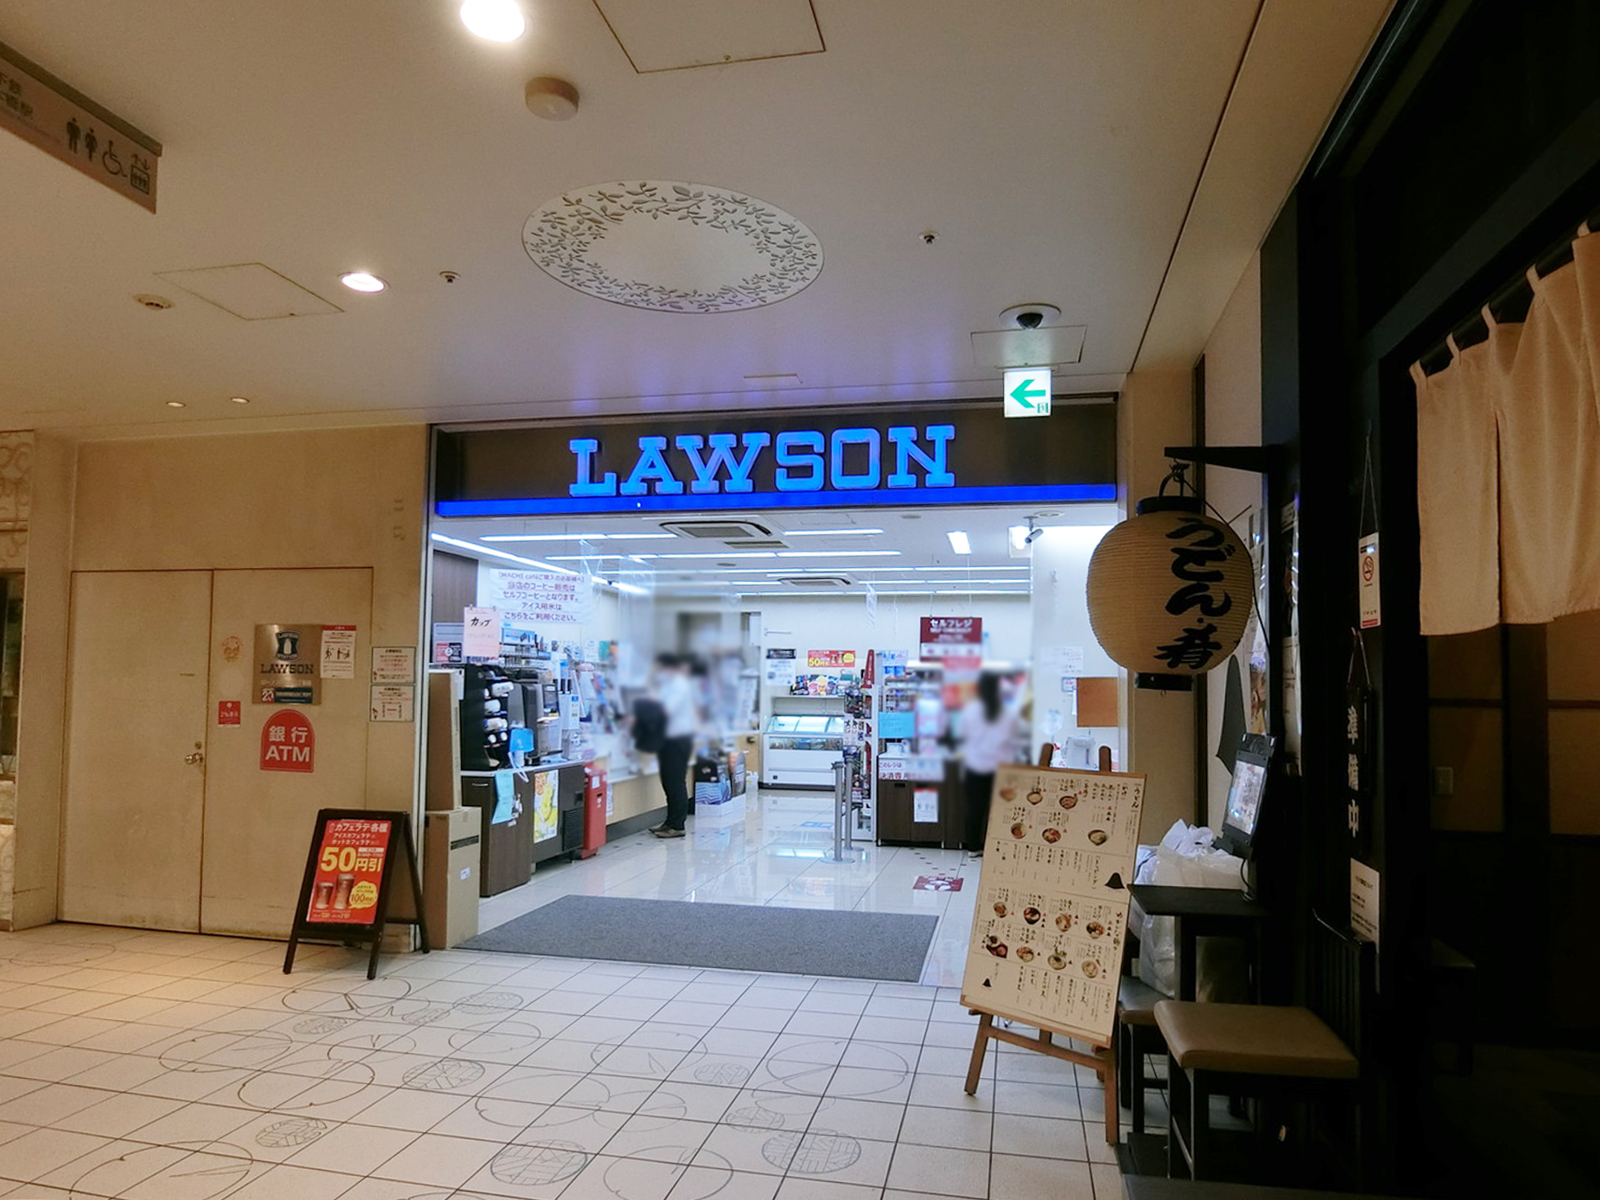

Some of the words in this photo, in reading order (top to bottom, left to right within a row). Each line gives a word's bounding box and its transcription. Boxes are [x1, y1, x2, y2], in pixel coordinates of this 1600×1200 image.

[568, 424, 957, 498] LAWSON
[504, 611, 577, 622] こちらをご利用ください。
[259, 663, 314, 675] LAWSON
[268, 725, 309, 744] 銀行
[265, 745, 311, 763] ATM
[334, 822, 389, 833] カフェラテ各種
[320, 846, 382, 872] 50円引
